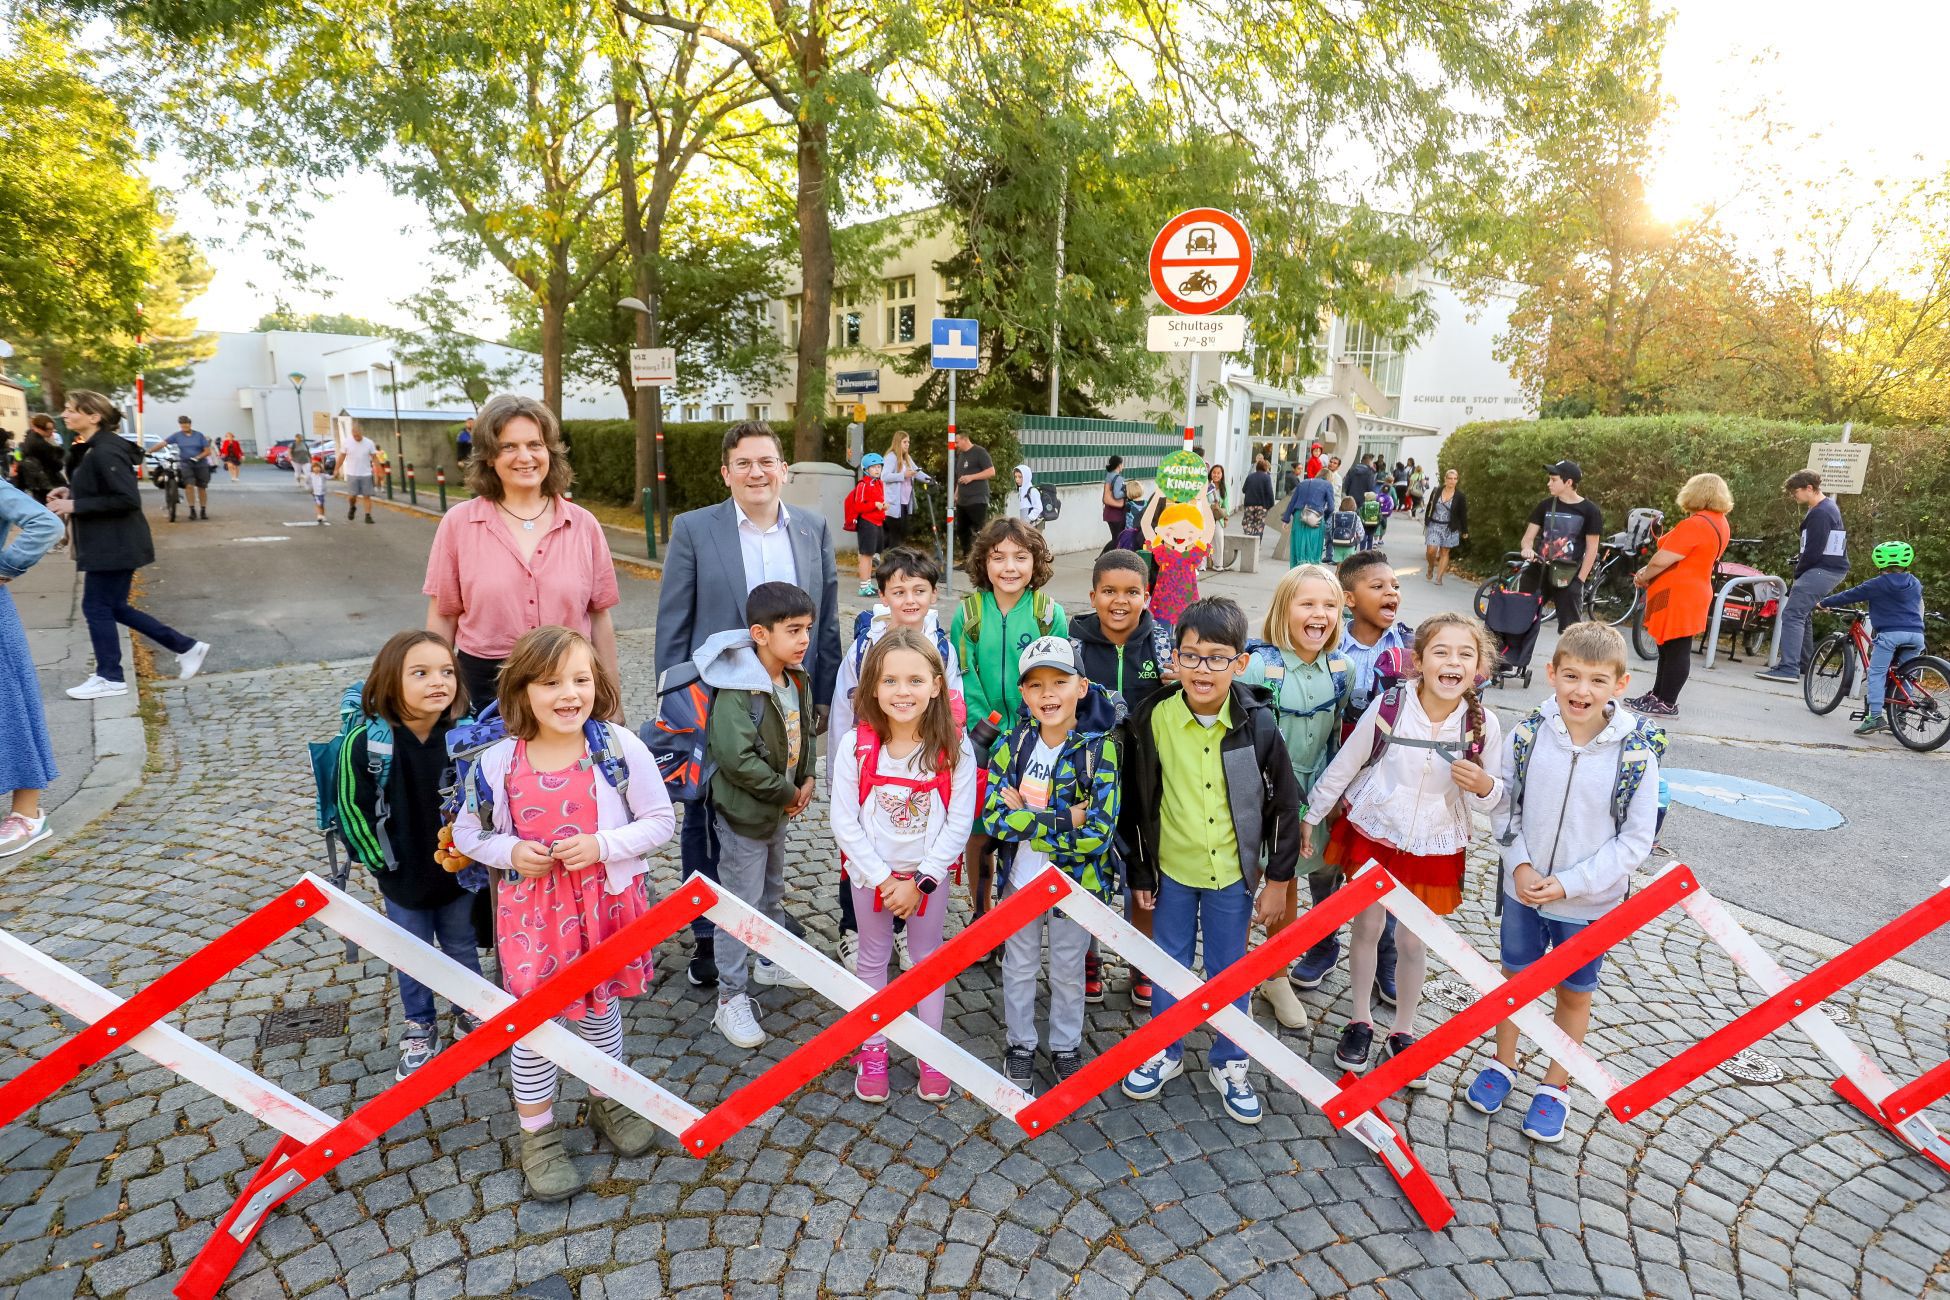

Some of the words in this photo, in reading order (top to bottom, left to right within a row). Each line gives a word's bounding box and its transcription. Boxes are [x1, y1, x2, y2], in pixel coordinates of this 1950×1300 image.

[1168, 320, 1223, 332] Schultags
[1413, 395, 1445, 403] SCHULE
[1473, 396, 1499, 404] STADT
[1164, 465, 1207, 476] ACHTUNG
[1166, 477, 1204, 491] KINDER
[1138, 671, 1158, 679] XBO
